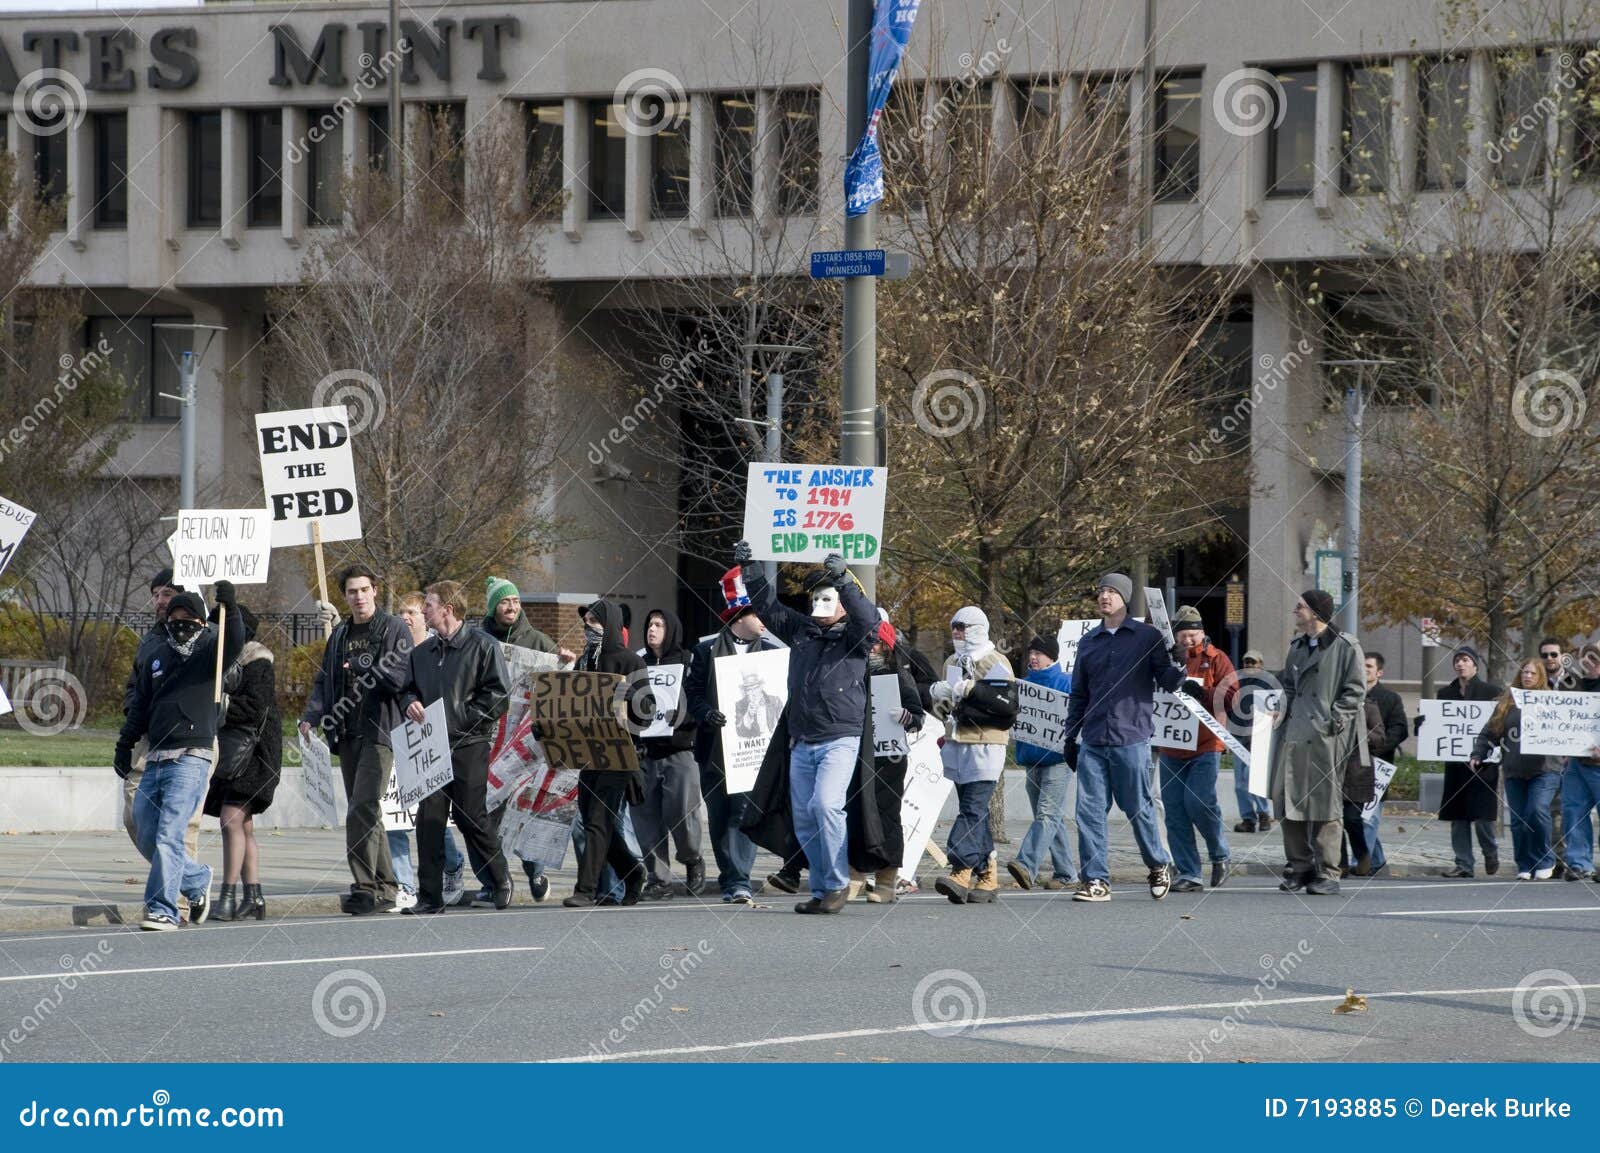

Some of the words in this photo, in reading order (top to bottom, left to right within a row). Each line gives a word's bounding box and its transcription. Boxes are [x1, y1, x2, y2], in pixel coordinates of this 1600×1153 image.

[268, 17, 520, 88] MINT
[813, 254, 821, 263] 32
[822, 253, 842, 263] STARS
[844, 251, 883, 261] (1858-1859)
[825, 265, 871, 275] (MINNESOTA)
[260, 421, 348, 454] END
[284, 462, 326, 479] THE
[763, 469, 802, 485] THE
[808, 468, 874, 487] ANSWER
[271, 488, 354, 521] FED
[776, 488, 798, 501] TO
[807, 487, 852, 507] 1984
[181, 517, 229, 540] RETURN
[240, 516, 255, 539] TO
[773, 508, 797, 527] IS
[802, 511, 854, 531] 1776
[771, 532, 809, 553] END
[812, 534, 840, 549] THE
[842, 533, 878, 559] FED
[180, 554, 217, 578] SOUND
[224, 553, 259, 577] MONEY
[537, 673, 613, 698] STOP
[535, 696, 616, 718] KILLING
[1523, 691, 1589, 705] ENVISION:
[1442, 702, 1481, 720] END
[405, 721, 433, 750] END
[540, 719, 572, 739] US
[575, 718, 631, 738] WITH
[1163, 725, 1192, 743] FED
[1443, 723, 1482, 735] THE
[744, 738, 765, 748] WANT
[1437, 736, 1478, 756] FE
[409, 748, 441, 775] THE
[543, 739, 630, 769] DEBT
[1376, 760, 1394, 776] THE
